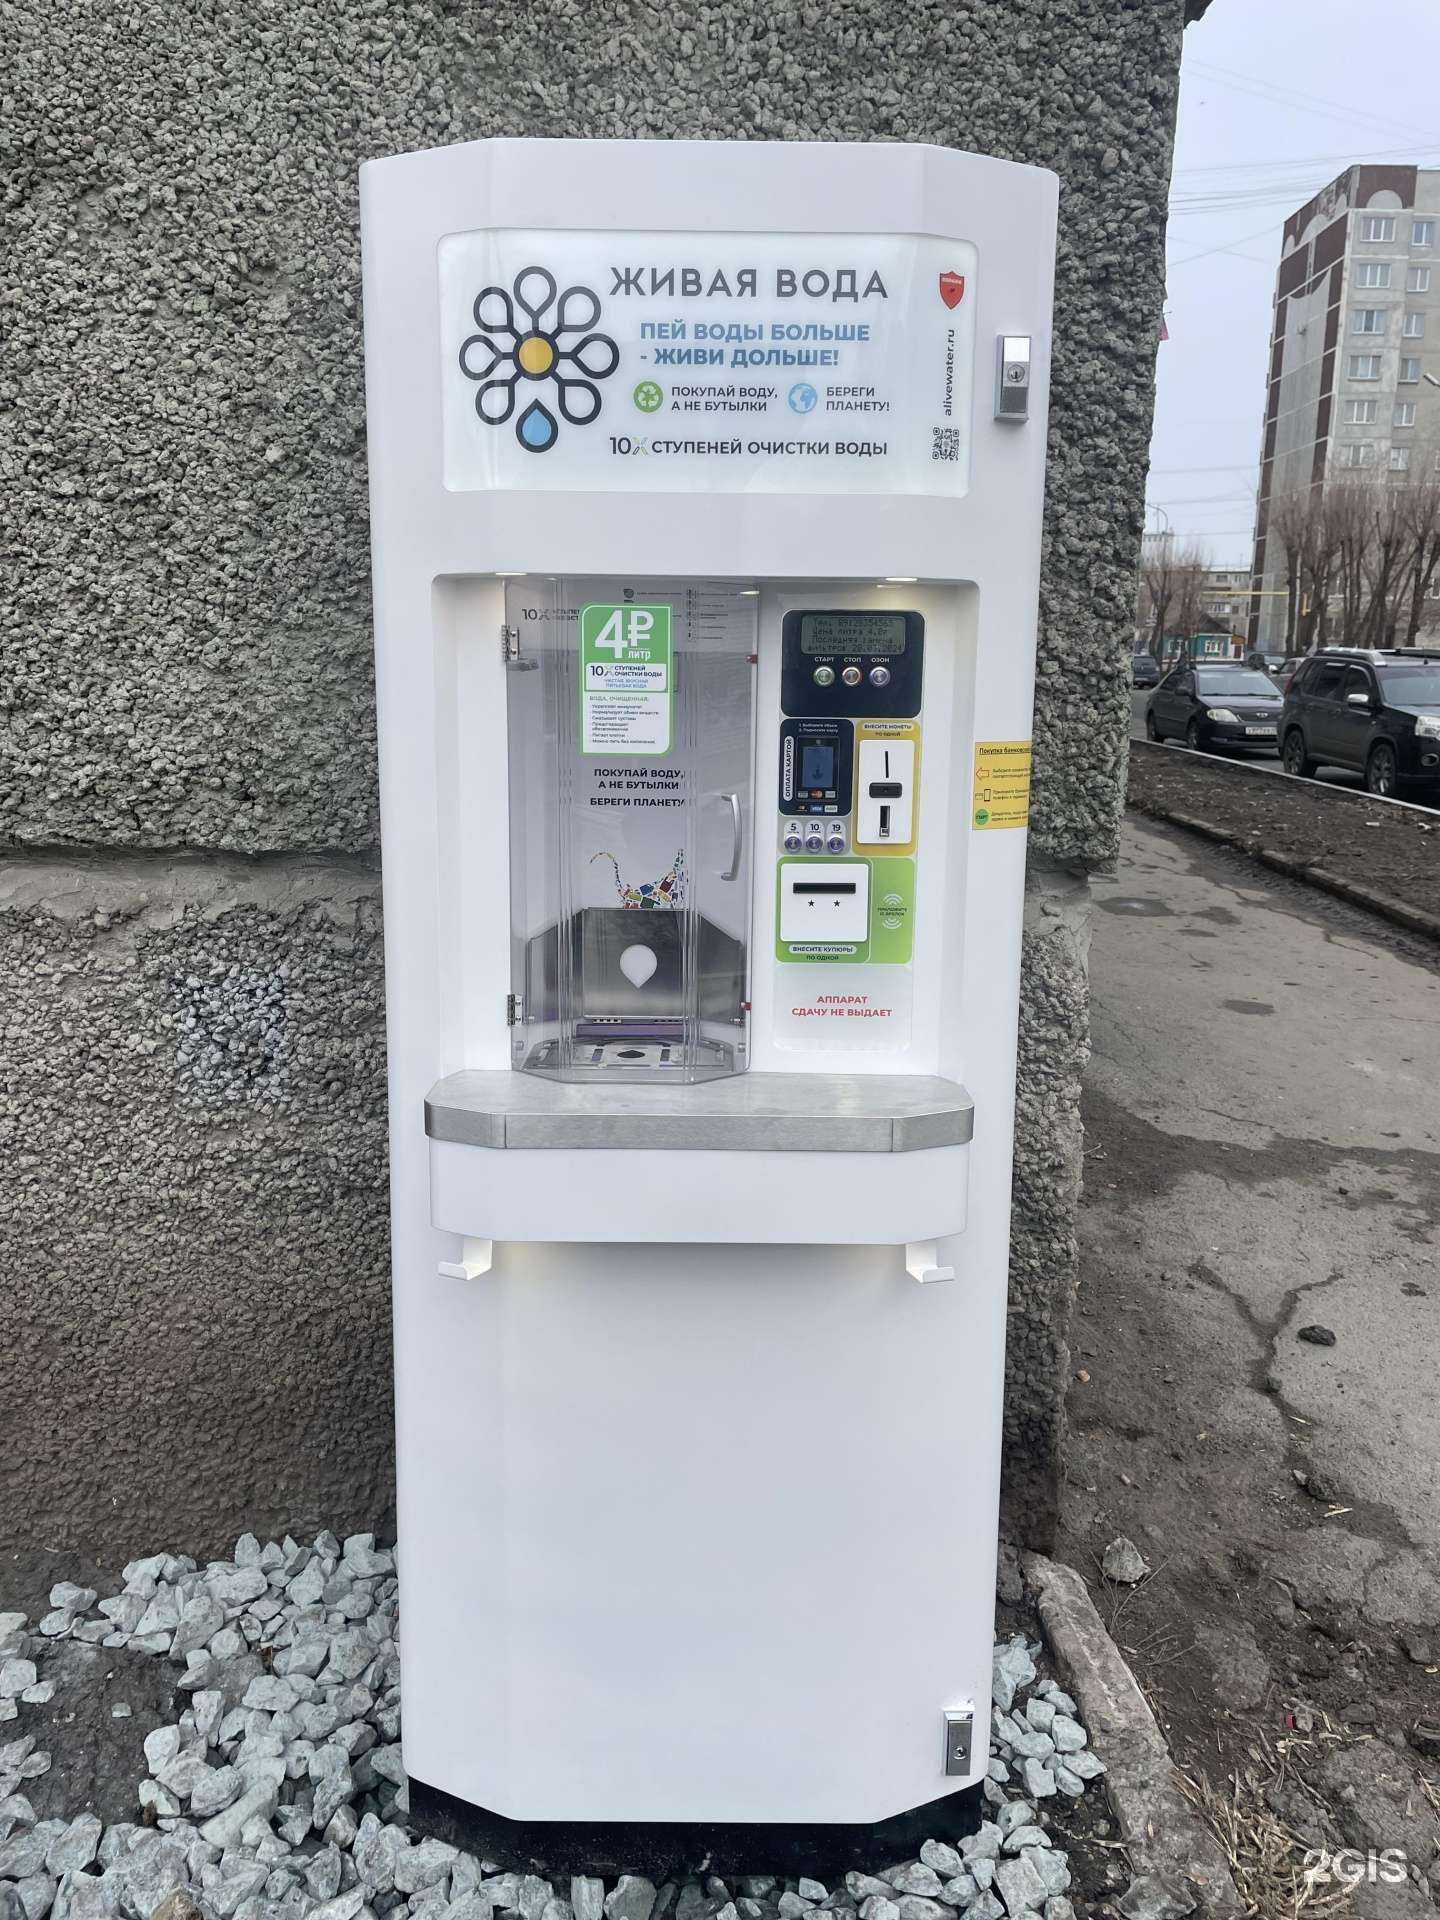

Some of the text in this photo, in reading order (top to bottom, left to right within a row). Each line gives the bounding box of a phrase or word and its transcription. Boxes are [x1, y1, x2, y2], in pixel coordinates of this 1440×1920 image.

[609, 267, 888, 303] ЖИВАЯ ВОДА
[640, 319, 870, 345] ПЕЙ ВОДЫ БОЛЬШЕ
[654, 347, 724, 366] ЖИВИ
[730, 348, 839, 370] ДОЛЬШЕ!
[944, 329, 955, 417] alivewater.ru
[671, 384, 778, 401] ПОКУПАЙ ВОДУ,
[826, 387, 875, 398] БЕРЕГИ
[671, 400, 767, 412] А НЕ БУТЫЛКИ
[826, 400, 890, 413] ПЛАНЕТУ!
[609, 436, 888, 458] 10 СТУПЕНЕЙ ОЧИСТКИ ВОДЫ
[628, 650, 651, 661] литр
[591, 665, 604, 677] 10
[594, 766, 648, 778] ПОКУПАЙ
[598, 780, 680, 790] А НЕ БУТЫЛКИ
[590, 797, 631, 807] БЕРЕГИ
[790, 823, 797, 831] 5
[810, 823, 820, 831] 10
[832, 824, 841, 832] 19
[823, 946, 853, 954] КУПЮРЫ
[816, 995, 868, 1004] АППАРАТ
[791, 1007, 893, 1017] СДАЧУ НЕ ВЫДАЕТ
